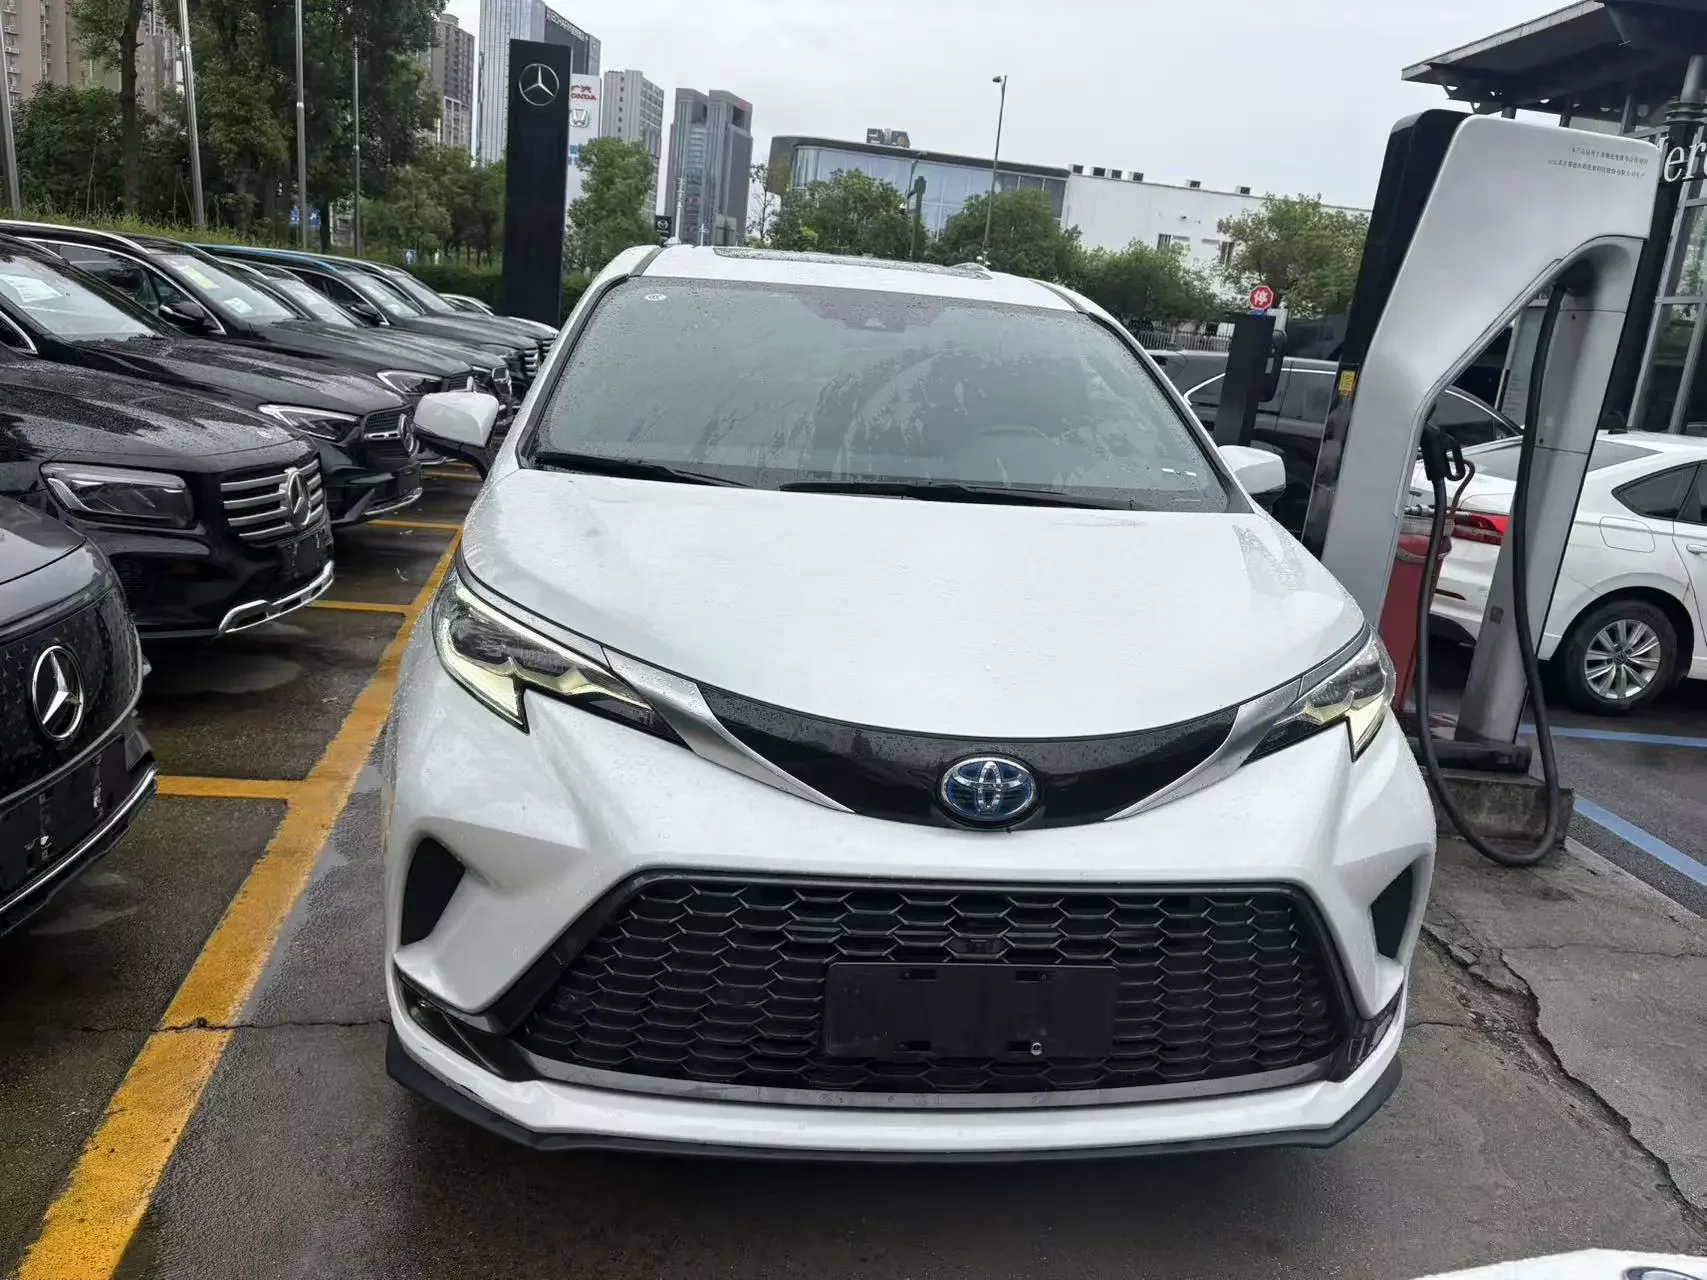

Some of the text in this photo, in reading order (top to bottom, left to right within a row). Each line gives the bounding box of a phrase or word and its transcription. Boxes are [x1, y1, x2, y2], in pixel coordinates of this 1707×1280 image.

[570, 93, 597, 101] ONDA
[1658, 136, 1707, 182] er
[1253, 289, 1269, 305] 停
